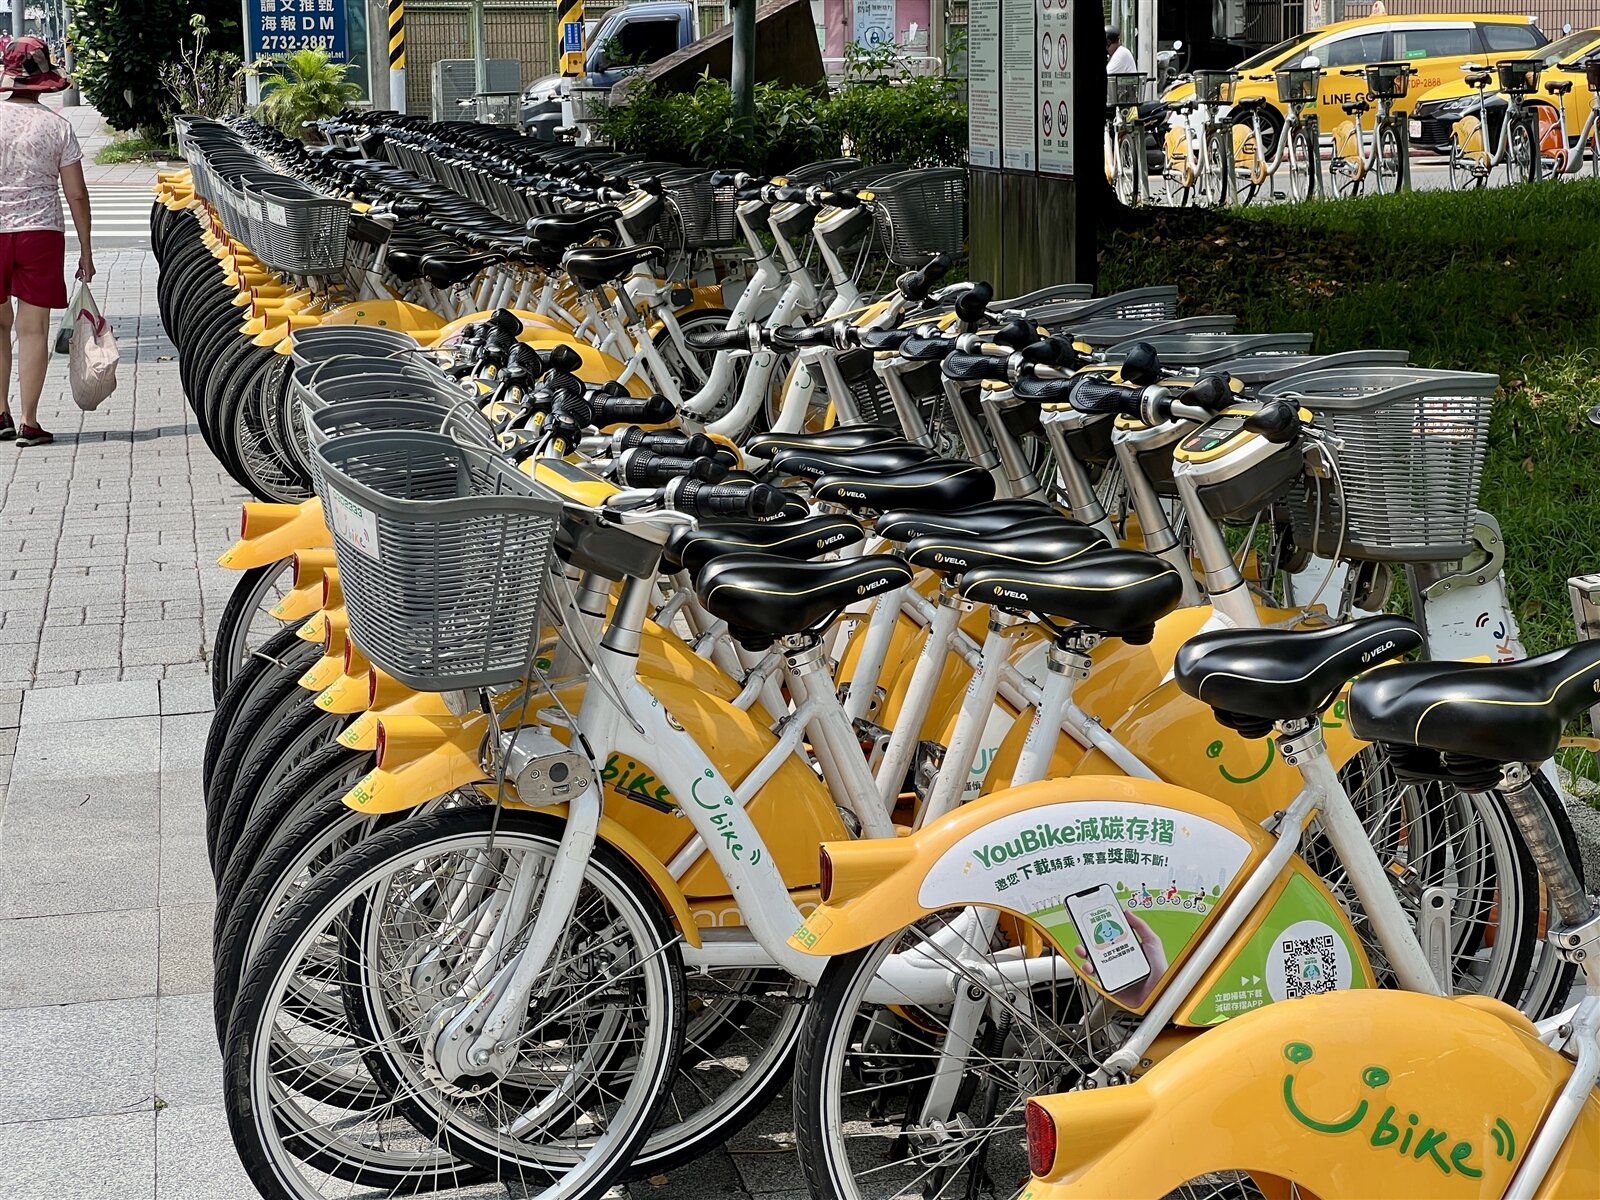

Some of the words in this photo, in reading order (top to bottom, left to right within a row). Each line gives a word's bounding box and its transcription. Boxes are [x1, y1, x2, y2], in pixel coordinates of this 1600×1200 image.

[261, 35, 335, 50] 2732-2887
[1322, 93, 1351, 105] LINE
[846, 490, 865, 499] VELO
[765, 512, 784, 522] VELO
[824, 533, 843, 546] VELO
[943, 556, 966, 567] VELO
[865, 578, 887, 592] VELO
[1003, 589, 1027, 601] VELO
[1369, 640, 1394, 658] VELO
